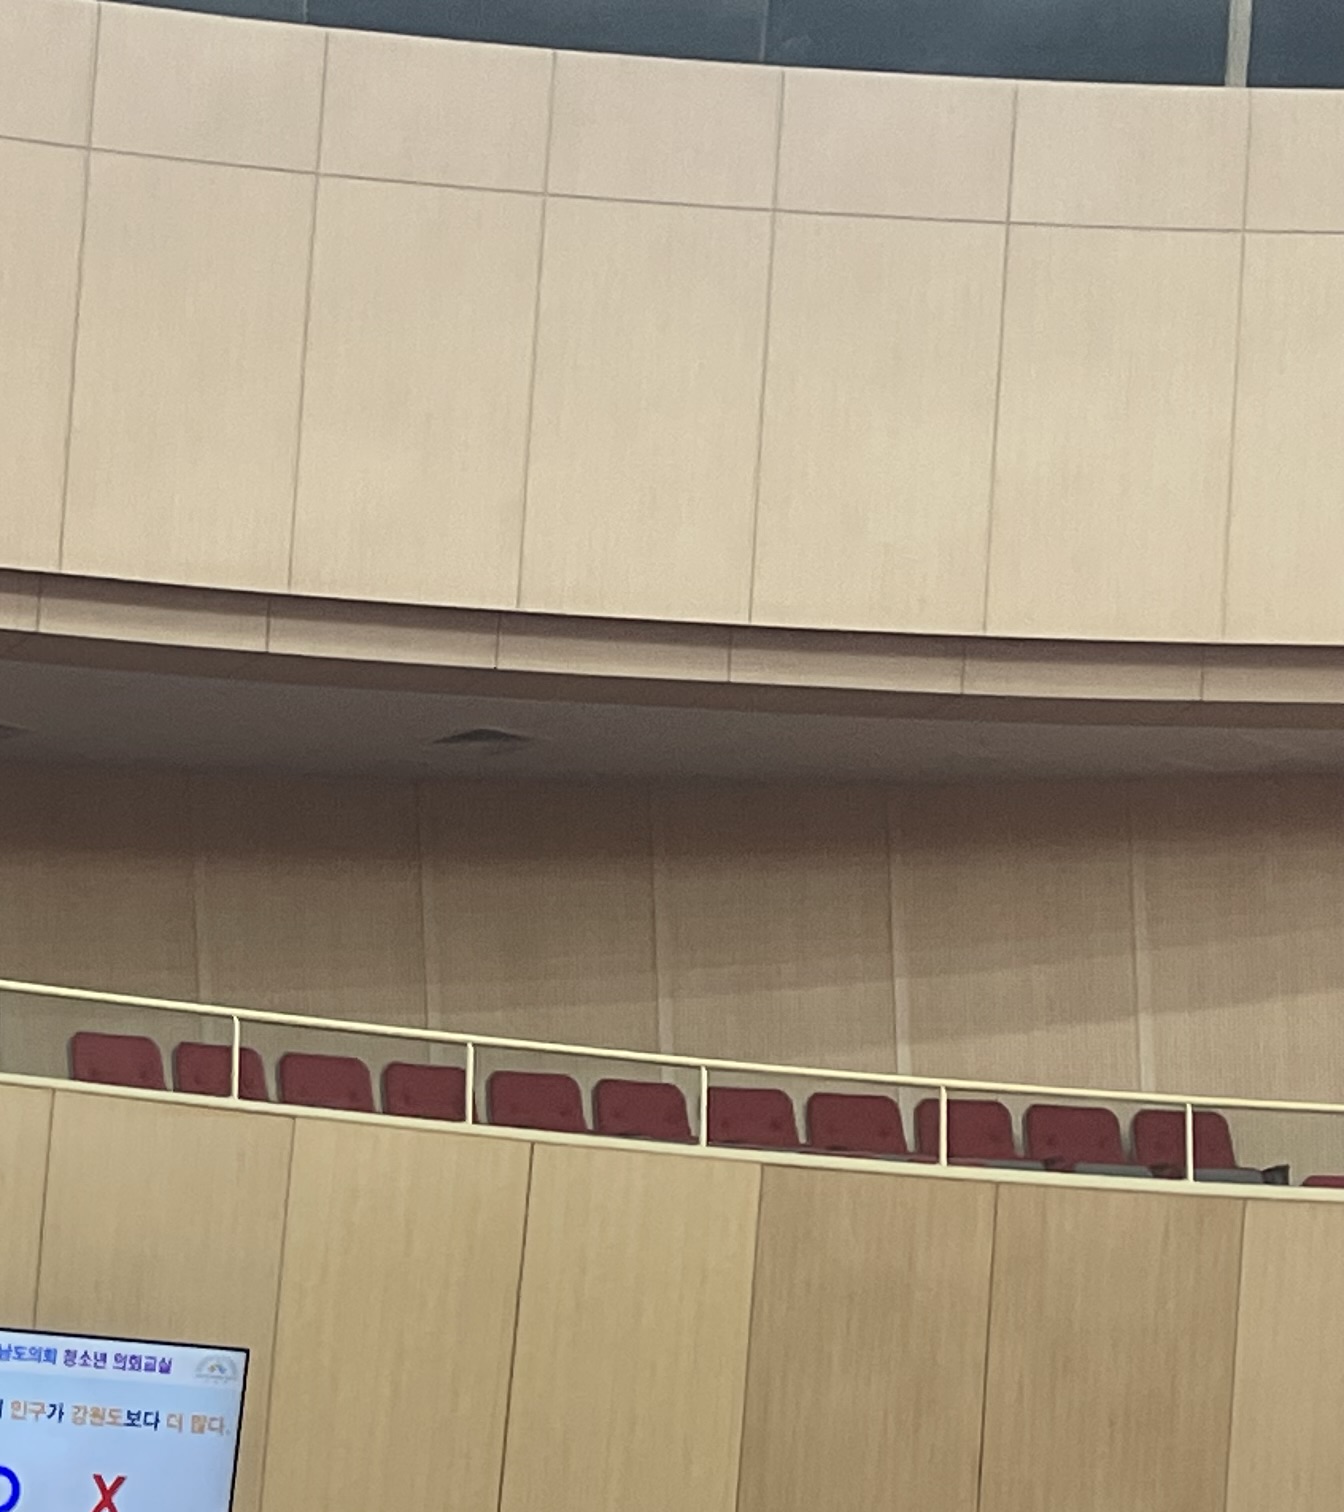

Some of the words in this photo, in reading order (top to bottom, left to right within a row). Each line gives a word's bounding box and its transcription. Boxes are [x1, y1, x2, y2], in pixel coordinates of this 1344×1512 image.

[63, 1349, 108, 1370] 청소년
[113, 1354, 172, 1375] 의회교실
[10, 1400, 64, 1423] 인구가
[71, 1406, 160, 1431] 강원도보다
[166, 1412, 183, 1433] 더
[191, 1415, 230, 1436] 많다.
